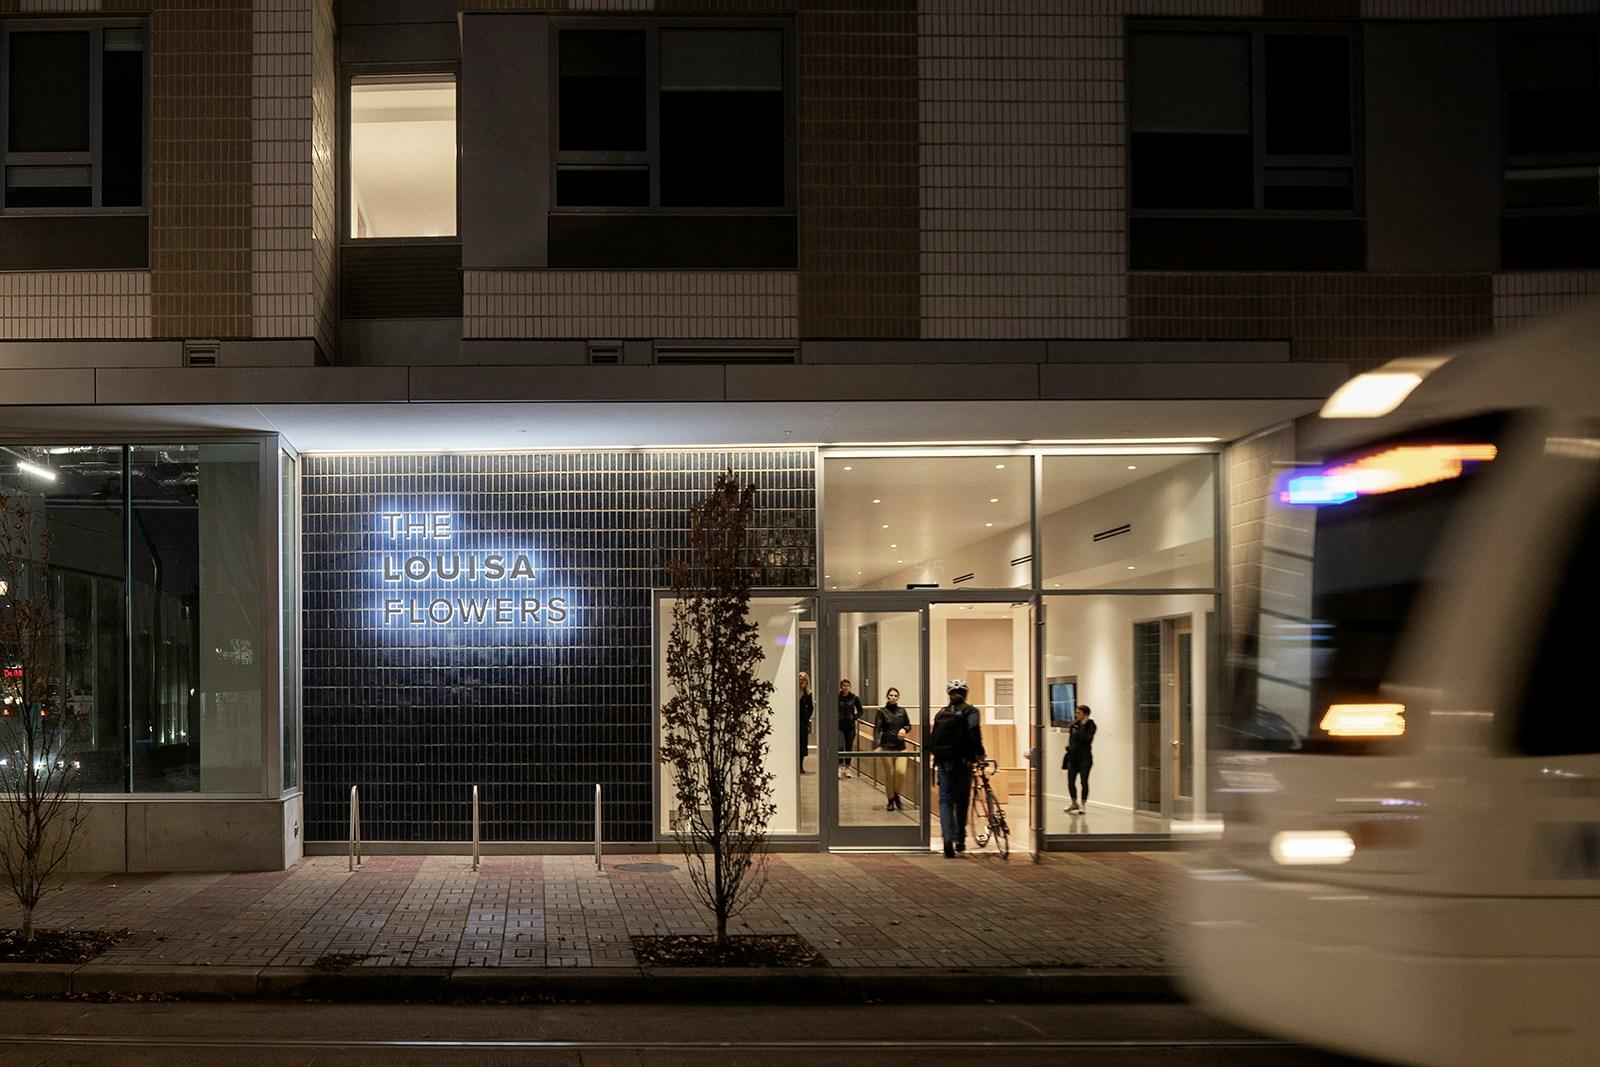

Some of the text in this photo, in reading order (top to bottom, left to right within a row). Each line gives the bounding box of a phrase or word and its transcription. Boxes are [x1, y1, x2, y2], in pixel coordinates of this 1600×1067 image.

[383, 513, 450, 538] THE
[384, 555, 536, 580] LOUISA
[385, 597, 567, 624] FLOWERS
